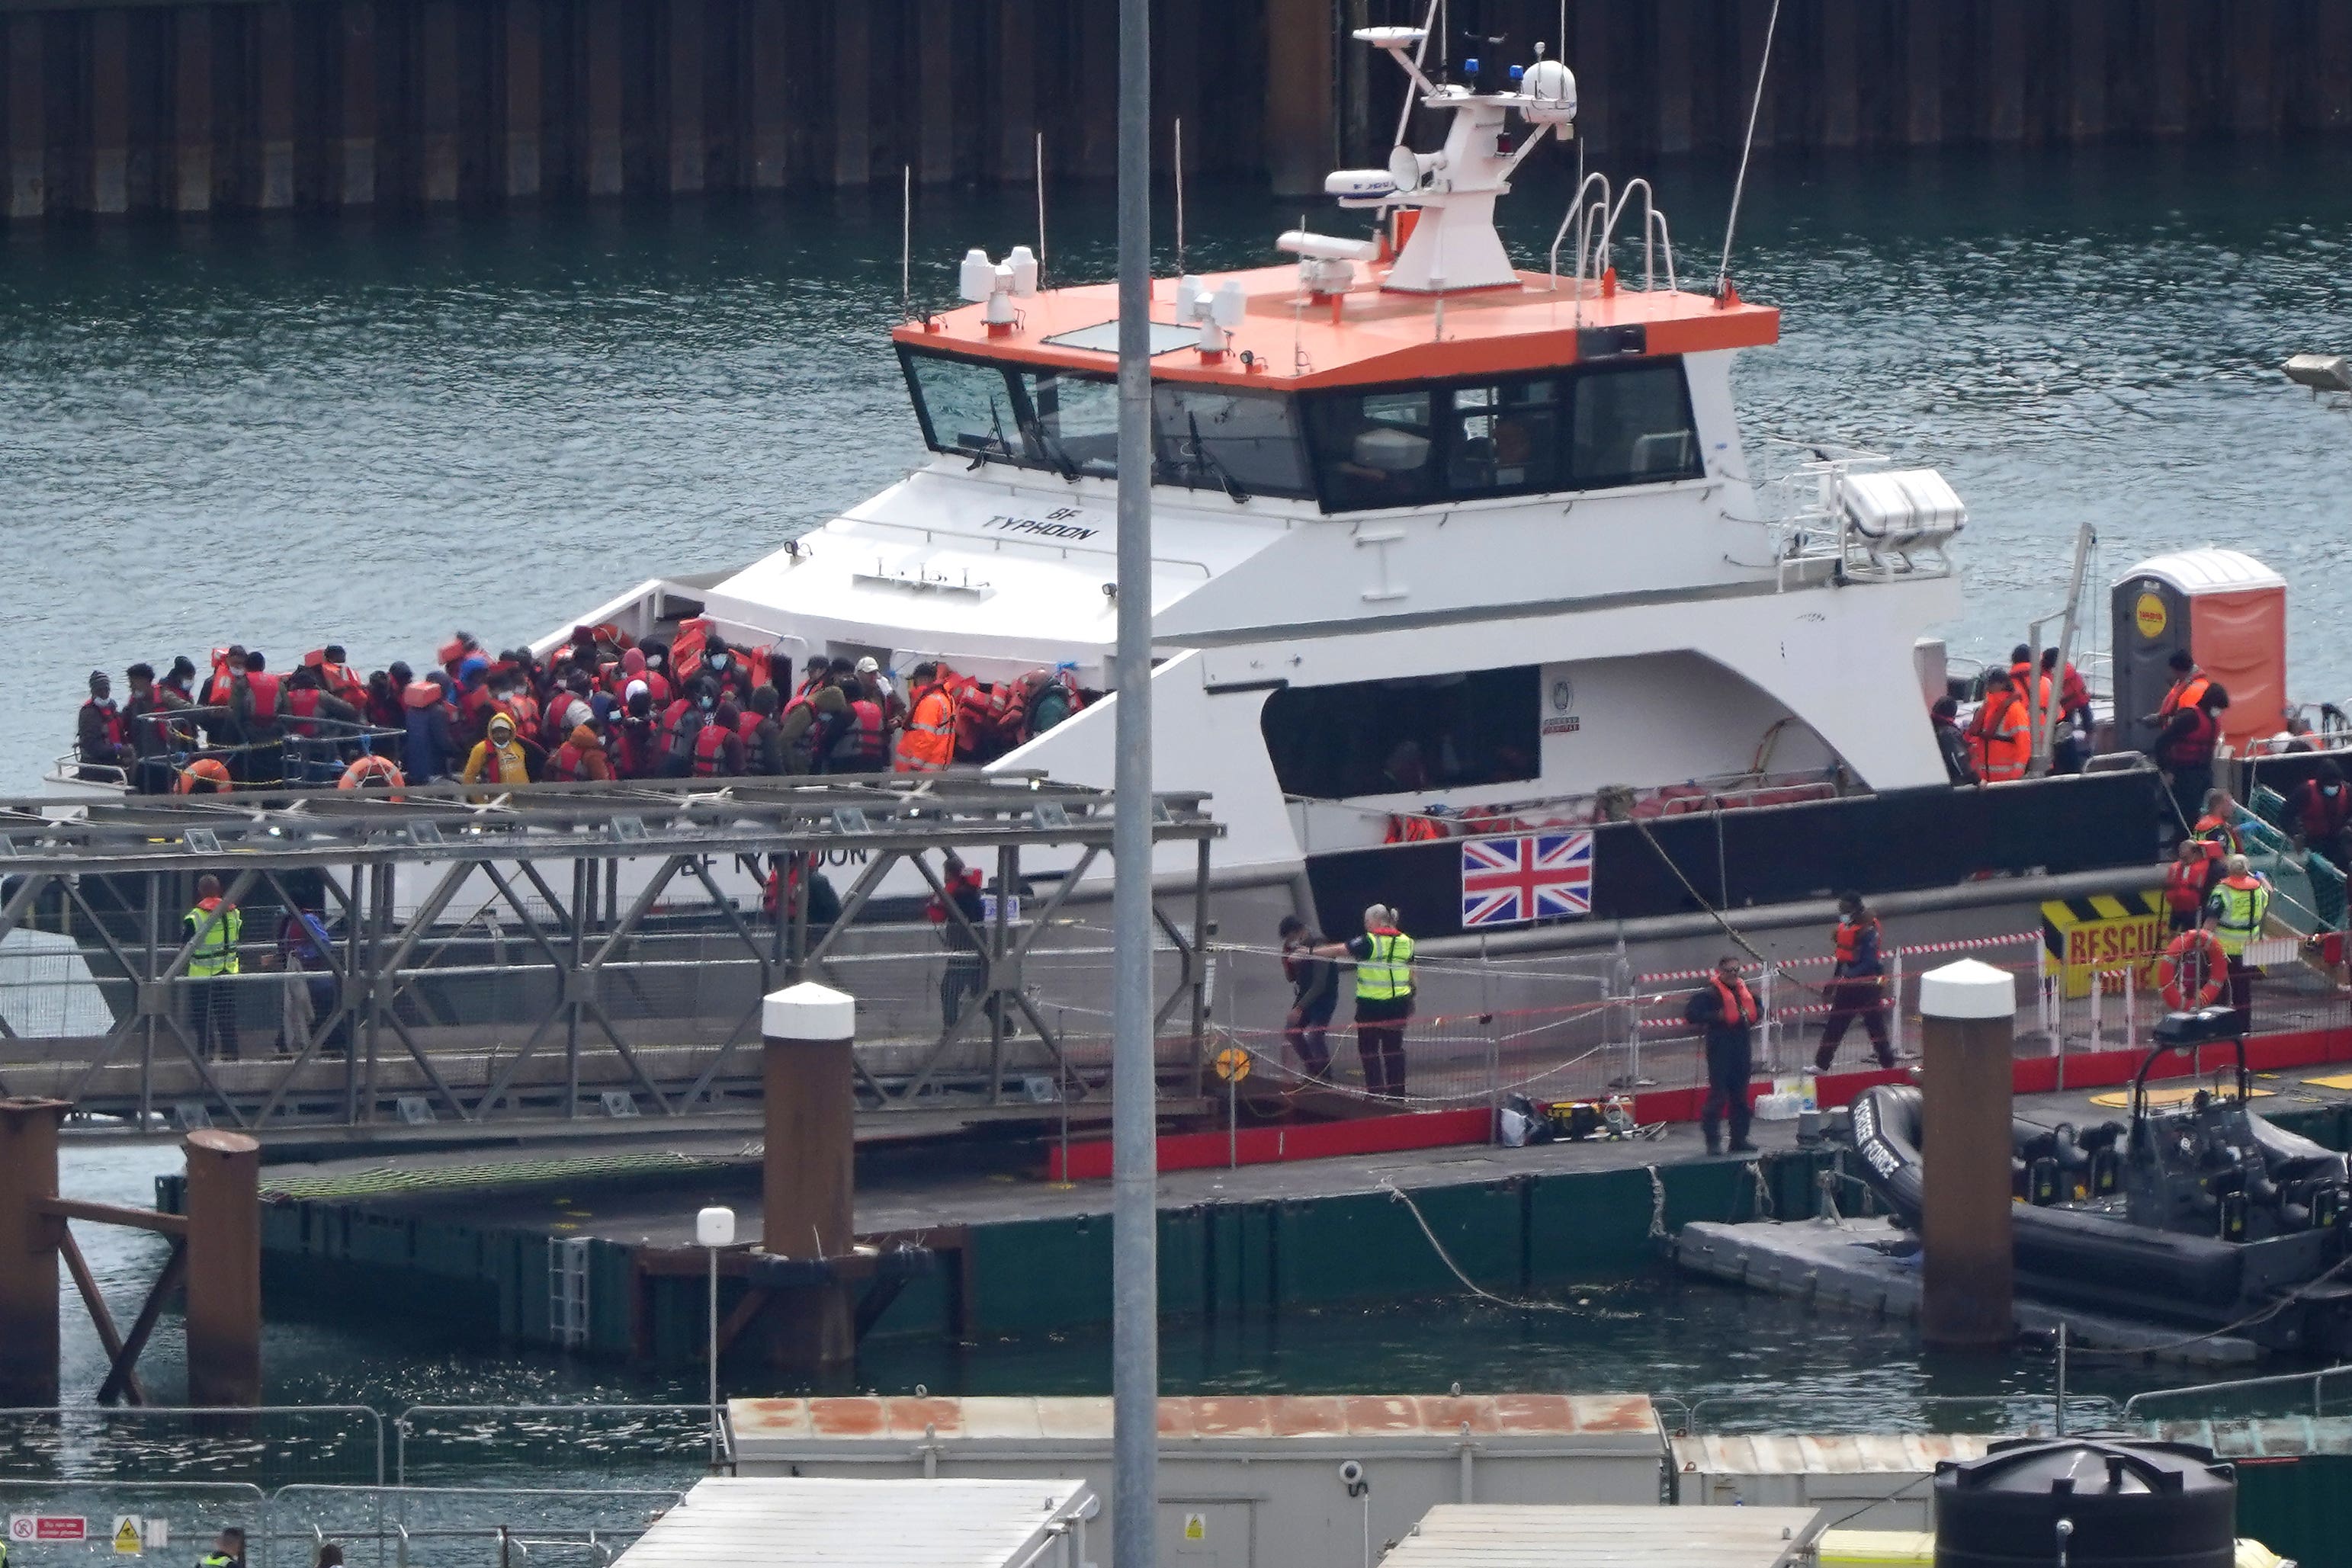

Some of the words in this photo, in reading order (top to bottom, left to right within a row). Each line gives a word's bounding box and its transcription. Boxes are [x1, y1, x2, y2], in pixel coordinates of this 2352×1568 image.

[983, 515, 1100, 540] TYPHOON
[1046, 508, 1083, 520] BF
[2071, 921, 2169, 964] RESCUE
[1855, 1098, 1873, 1146] BORDER
[1863, 1140, 1899, 1178] FORCE
